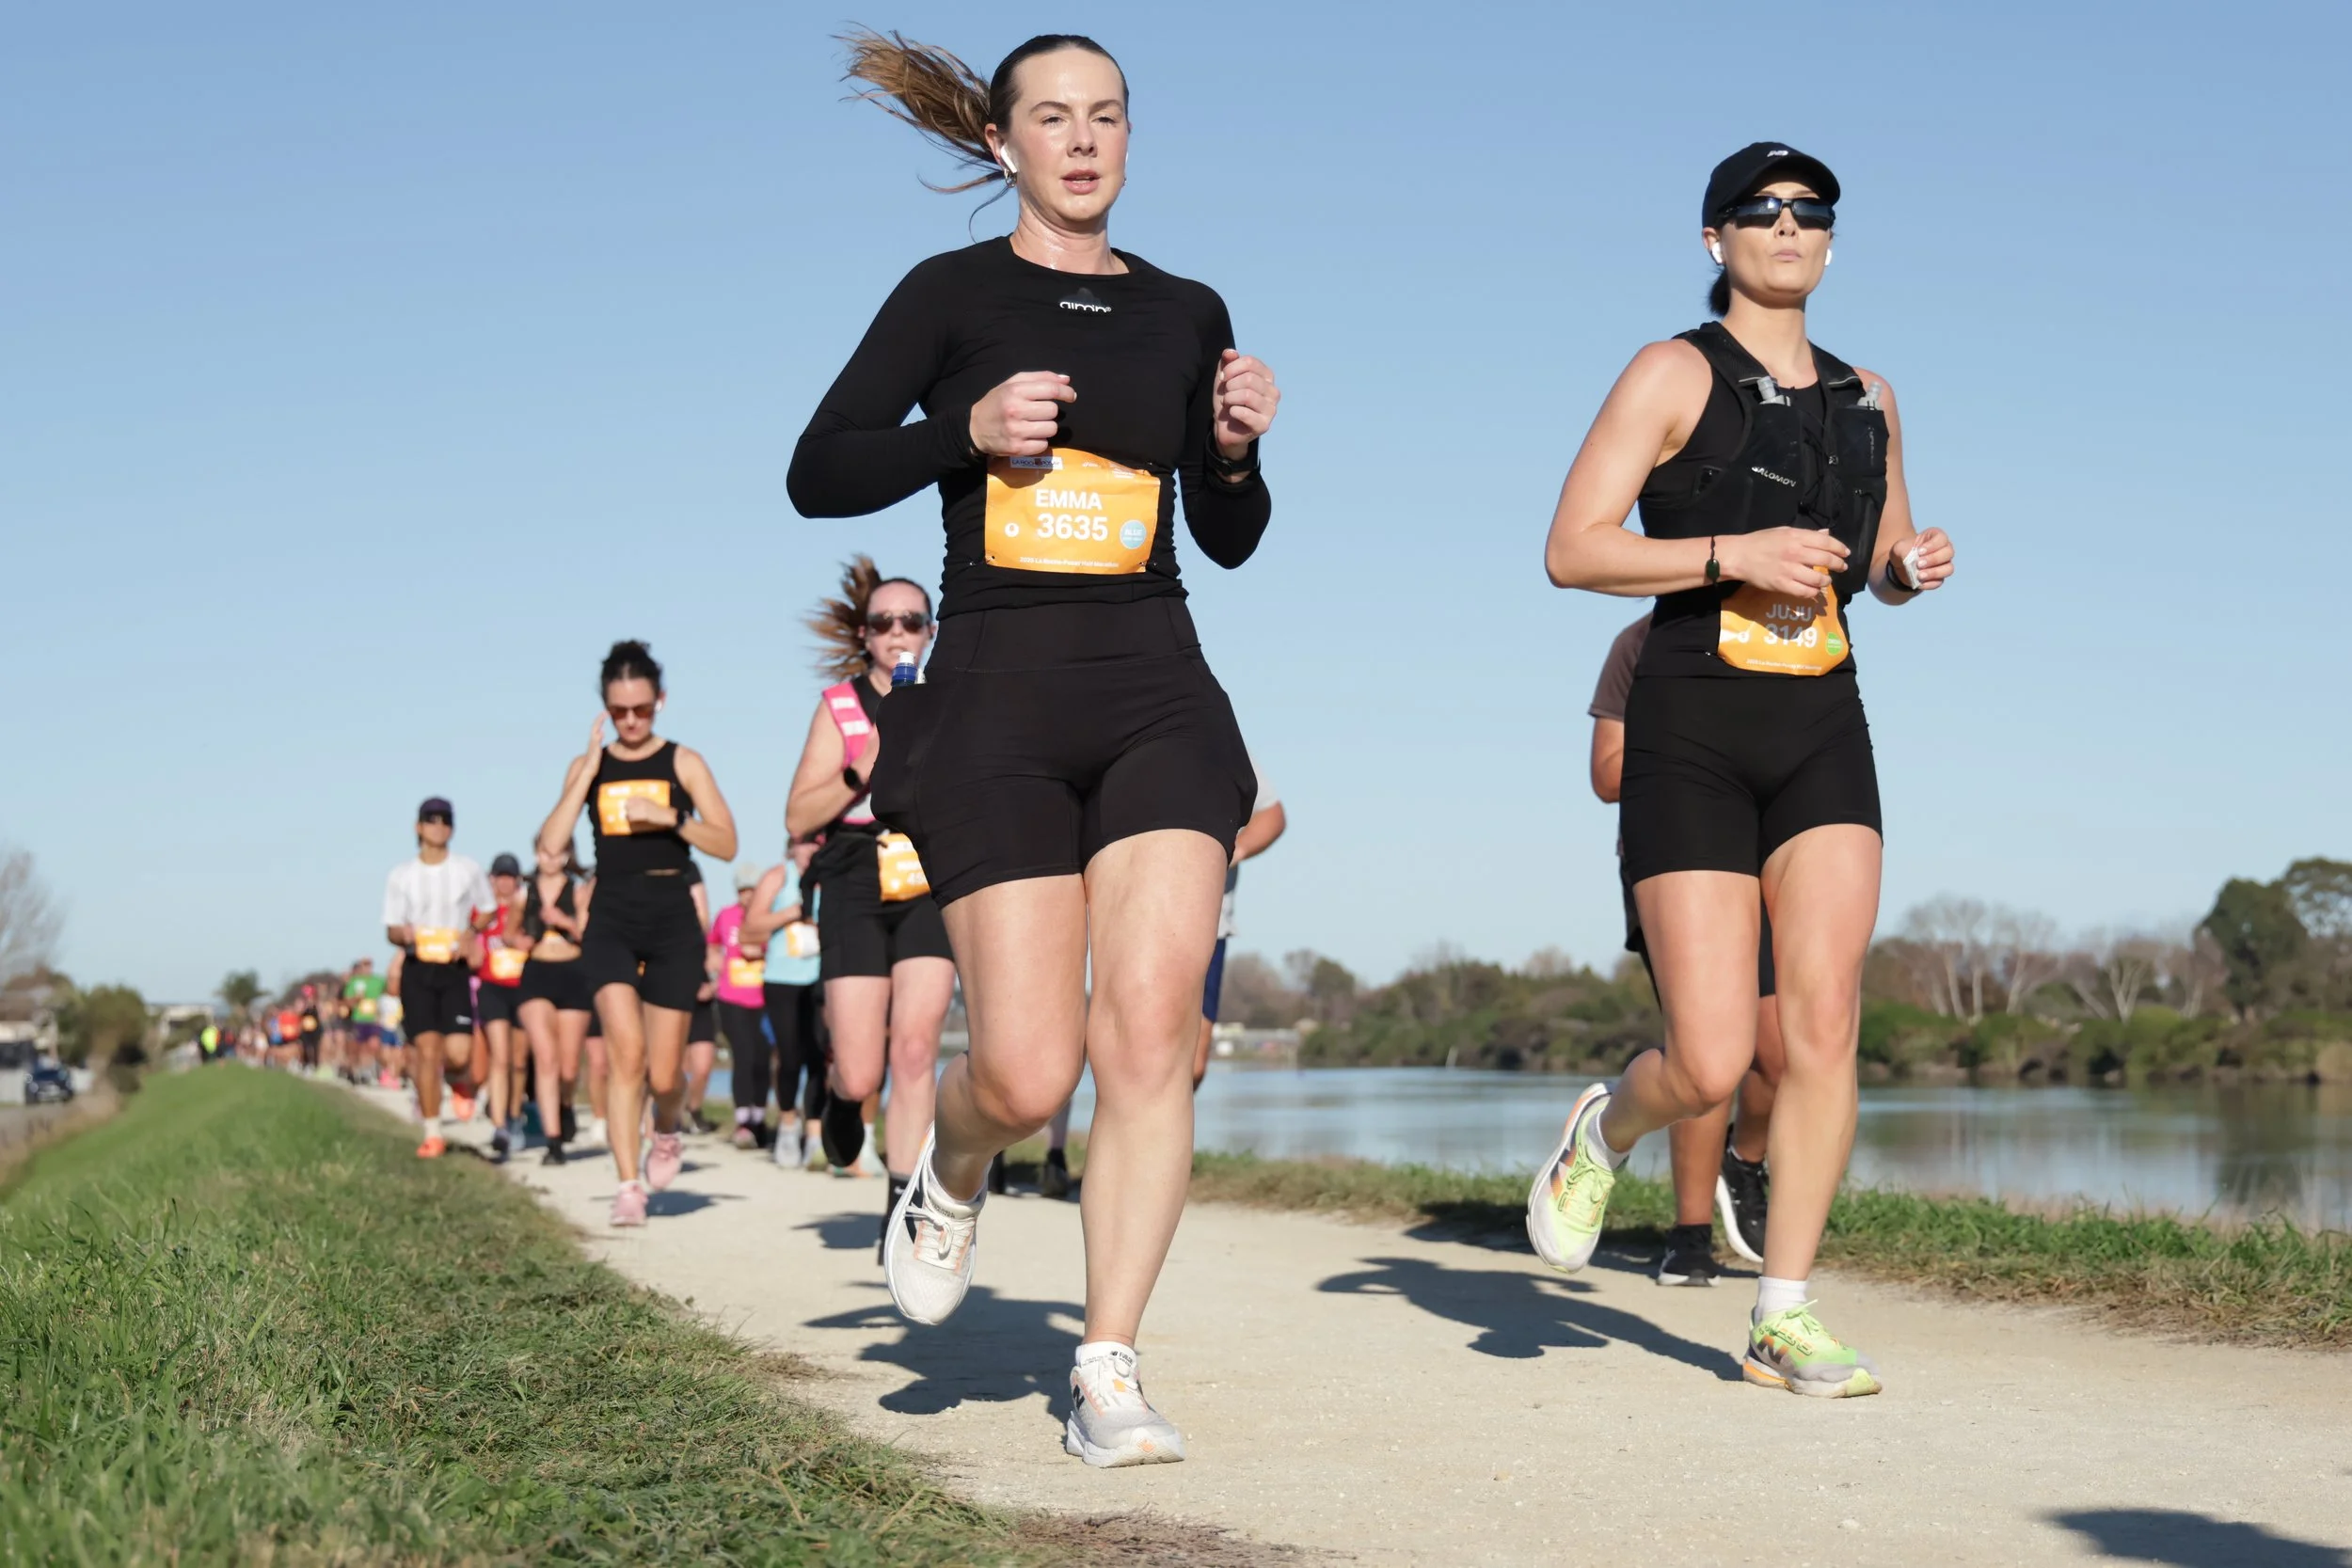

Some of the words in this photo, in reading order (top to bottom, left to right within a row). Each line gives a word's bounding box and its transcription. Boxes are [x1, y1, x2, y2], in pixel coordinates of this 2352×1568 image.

[1035, 488, 1103, 510] EMMA
[1037, 513, 1108, 542] 3635
[1766, 603, 1812, 623] JUJU
[1763, 623, 1818, 648] 3149
